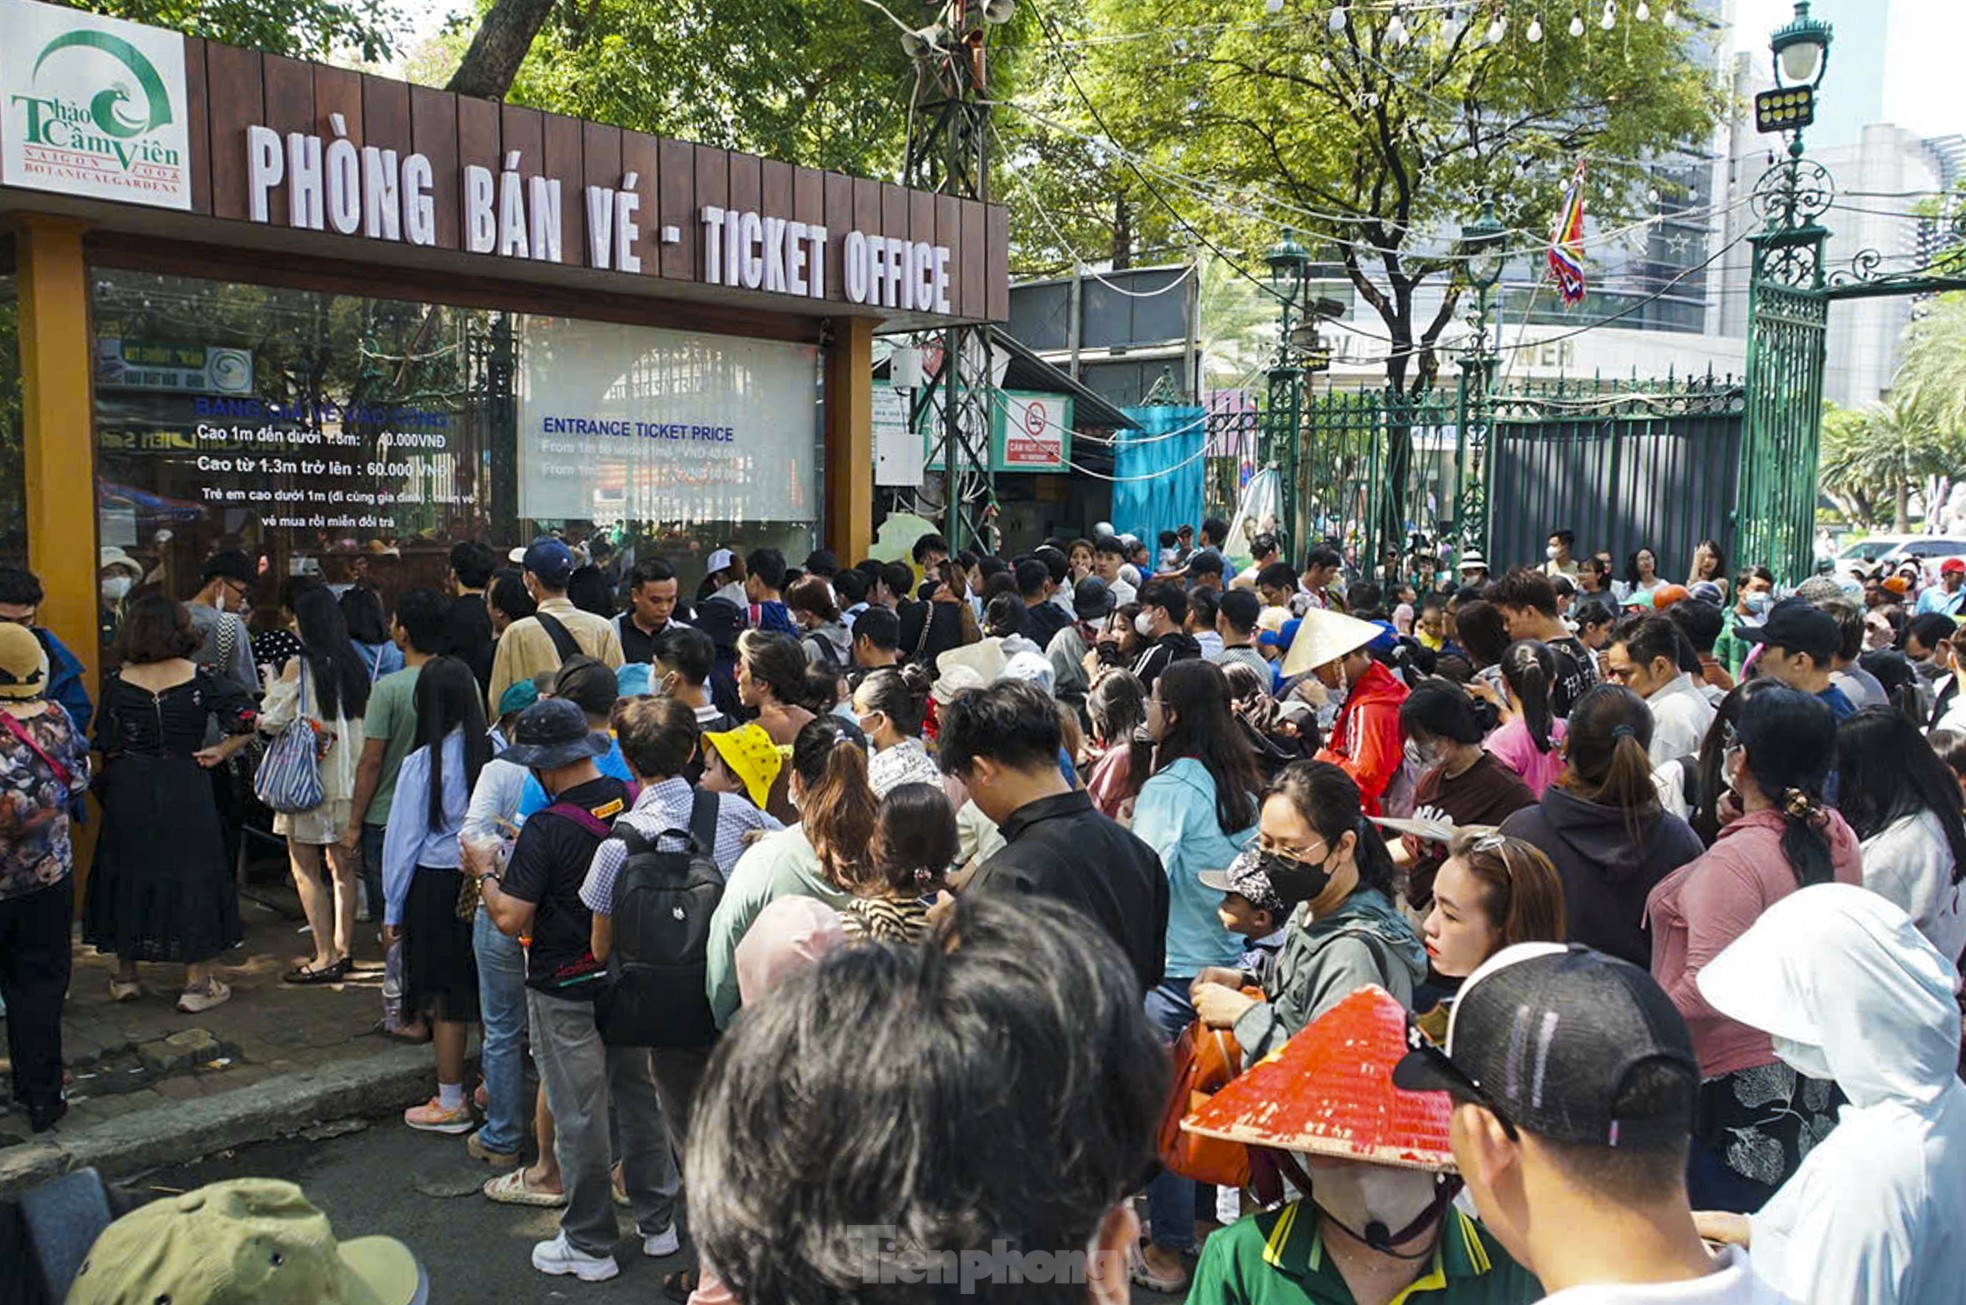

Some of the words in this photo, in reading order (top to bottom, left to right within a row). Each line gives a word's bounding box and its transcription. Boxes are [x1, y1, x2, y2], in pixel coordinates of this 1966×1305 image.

[10, 94, 92, 145] Thảo
[41, 118, 111, 154] Cầm
[111, 138, 180, 172] Viên
[247, 112, 436, 246] PHÒNG
[463, 150, 562, 263] BÁN
[584, 171, 641, 274] VÉ
[701, 205, 827, 299] TICKET
[843, 230, 951, 315] OFFICE
[197, 423, 228, 440] Cao
[230, 425, 253, 441] 1m
[543, 417, 631, 437] ENTRANCE
[635, 421, 688, 440] TICKET
[690, 425, 734, 442] PRICE
[541, 440, 575, 453] From
[197, 455, 232, 471] Cao
[235, 456, 256, 473] từ
[259, 458, 297, 474] 1.3m
[328, 461, 352, 475] lên
[366, 462, 413, 477] 60.000
[225, 490, 246, 500] em
[248, 490, 272, 501] cao
[307, 490, 326, 502] 1m
[280, 517, 306, 527] mua
